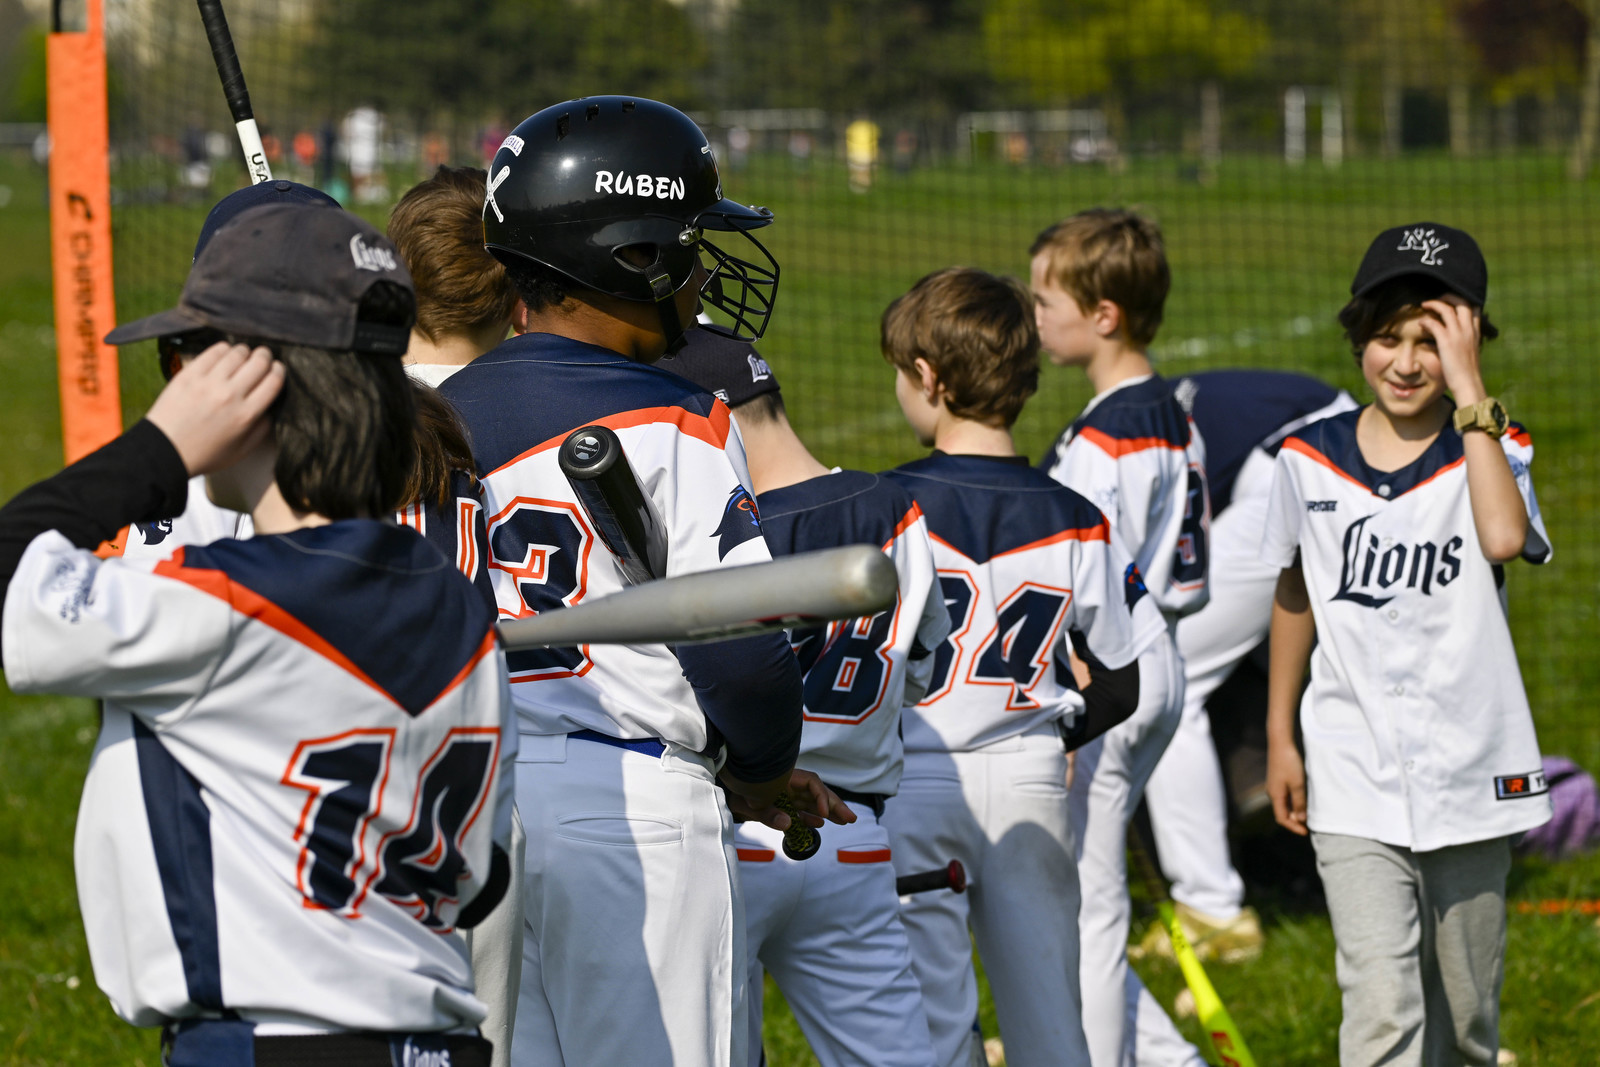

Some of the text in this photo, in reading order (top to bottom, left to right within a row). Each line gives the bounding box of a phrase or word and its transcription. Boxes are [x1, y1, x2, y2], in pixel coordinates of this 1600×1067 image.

[595, 170, 685, 200] RUBEN
[1327, 510, 1463, 610] Lions
[280, 726, 501, 934] 14
